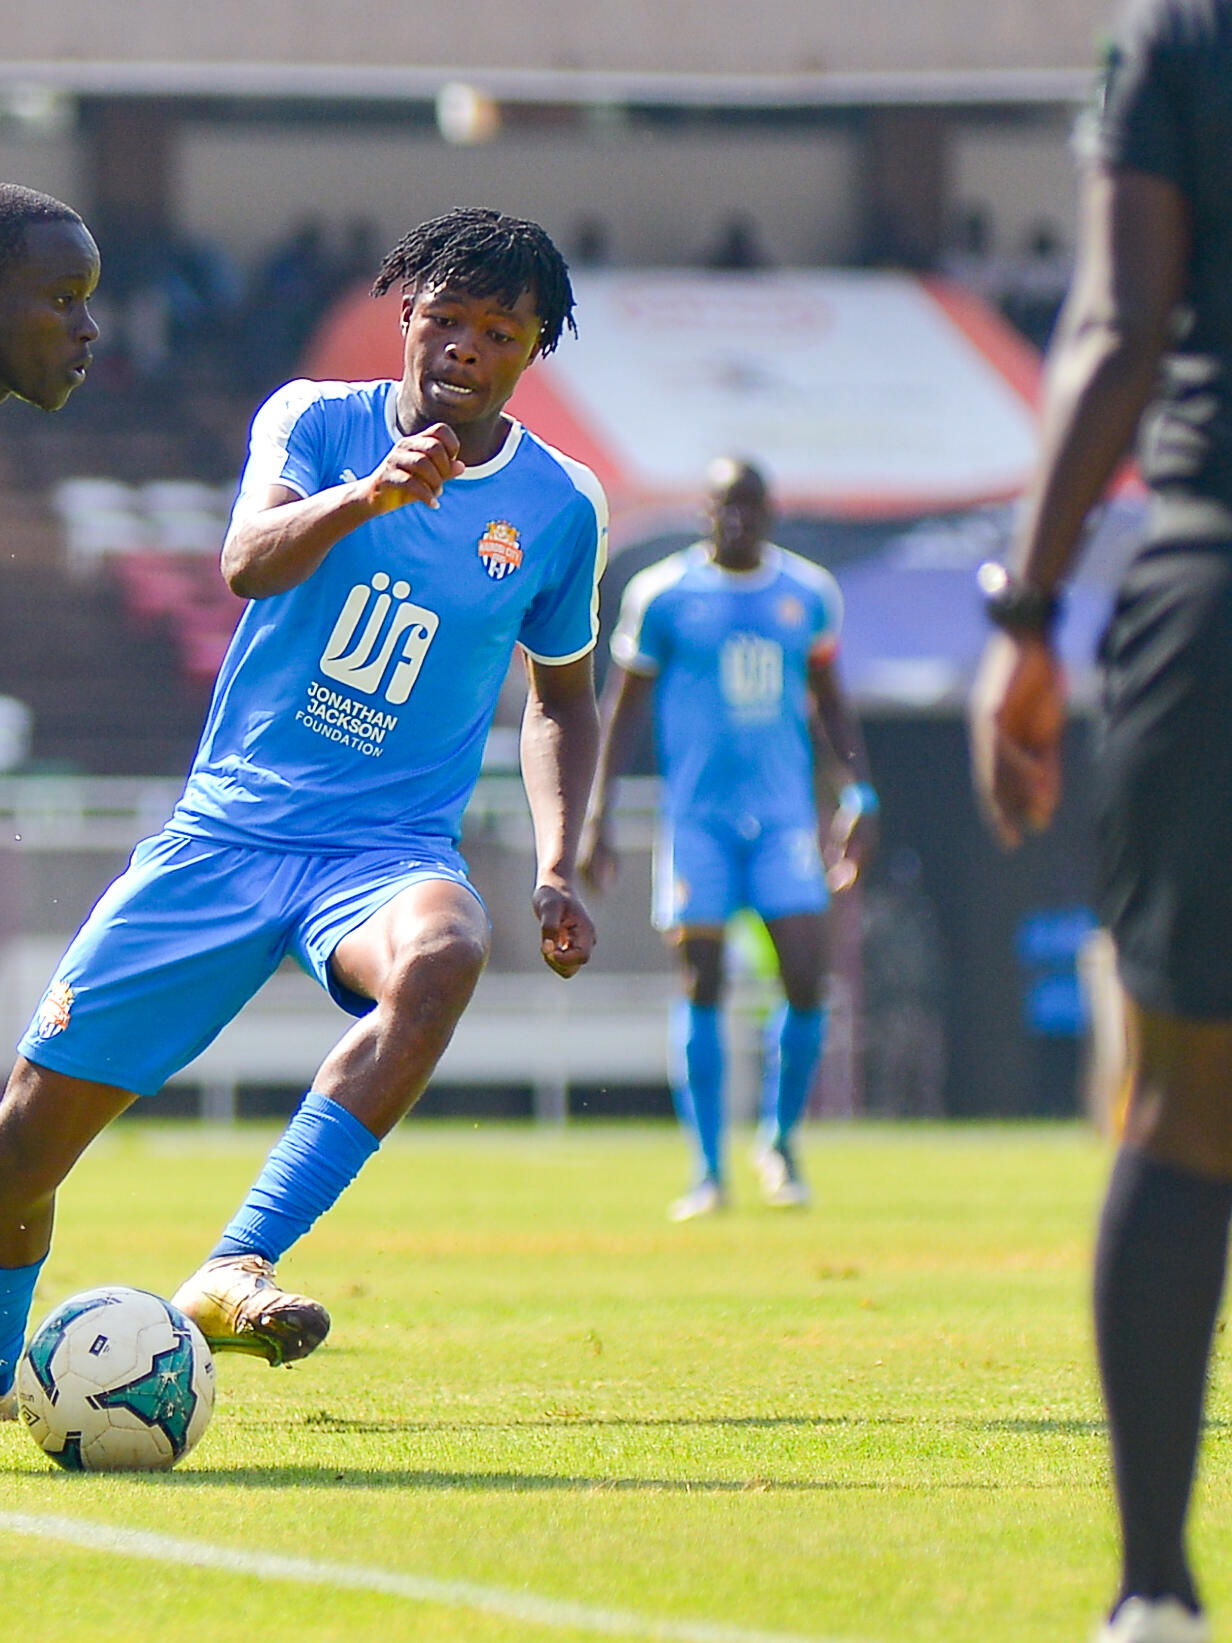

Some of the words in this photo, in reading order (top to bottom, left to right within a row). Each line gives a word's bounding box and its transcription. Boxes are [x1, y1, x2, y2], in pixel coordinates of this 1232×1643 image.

[307, 681, 398, 731] JONATHAN
[307, 698, 386, 744] JACKSON
[295, 710, 383, 758] FOUNDATION
